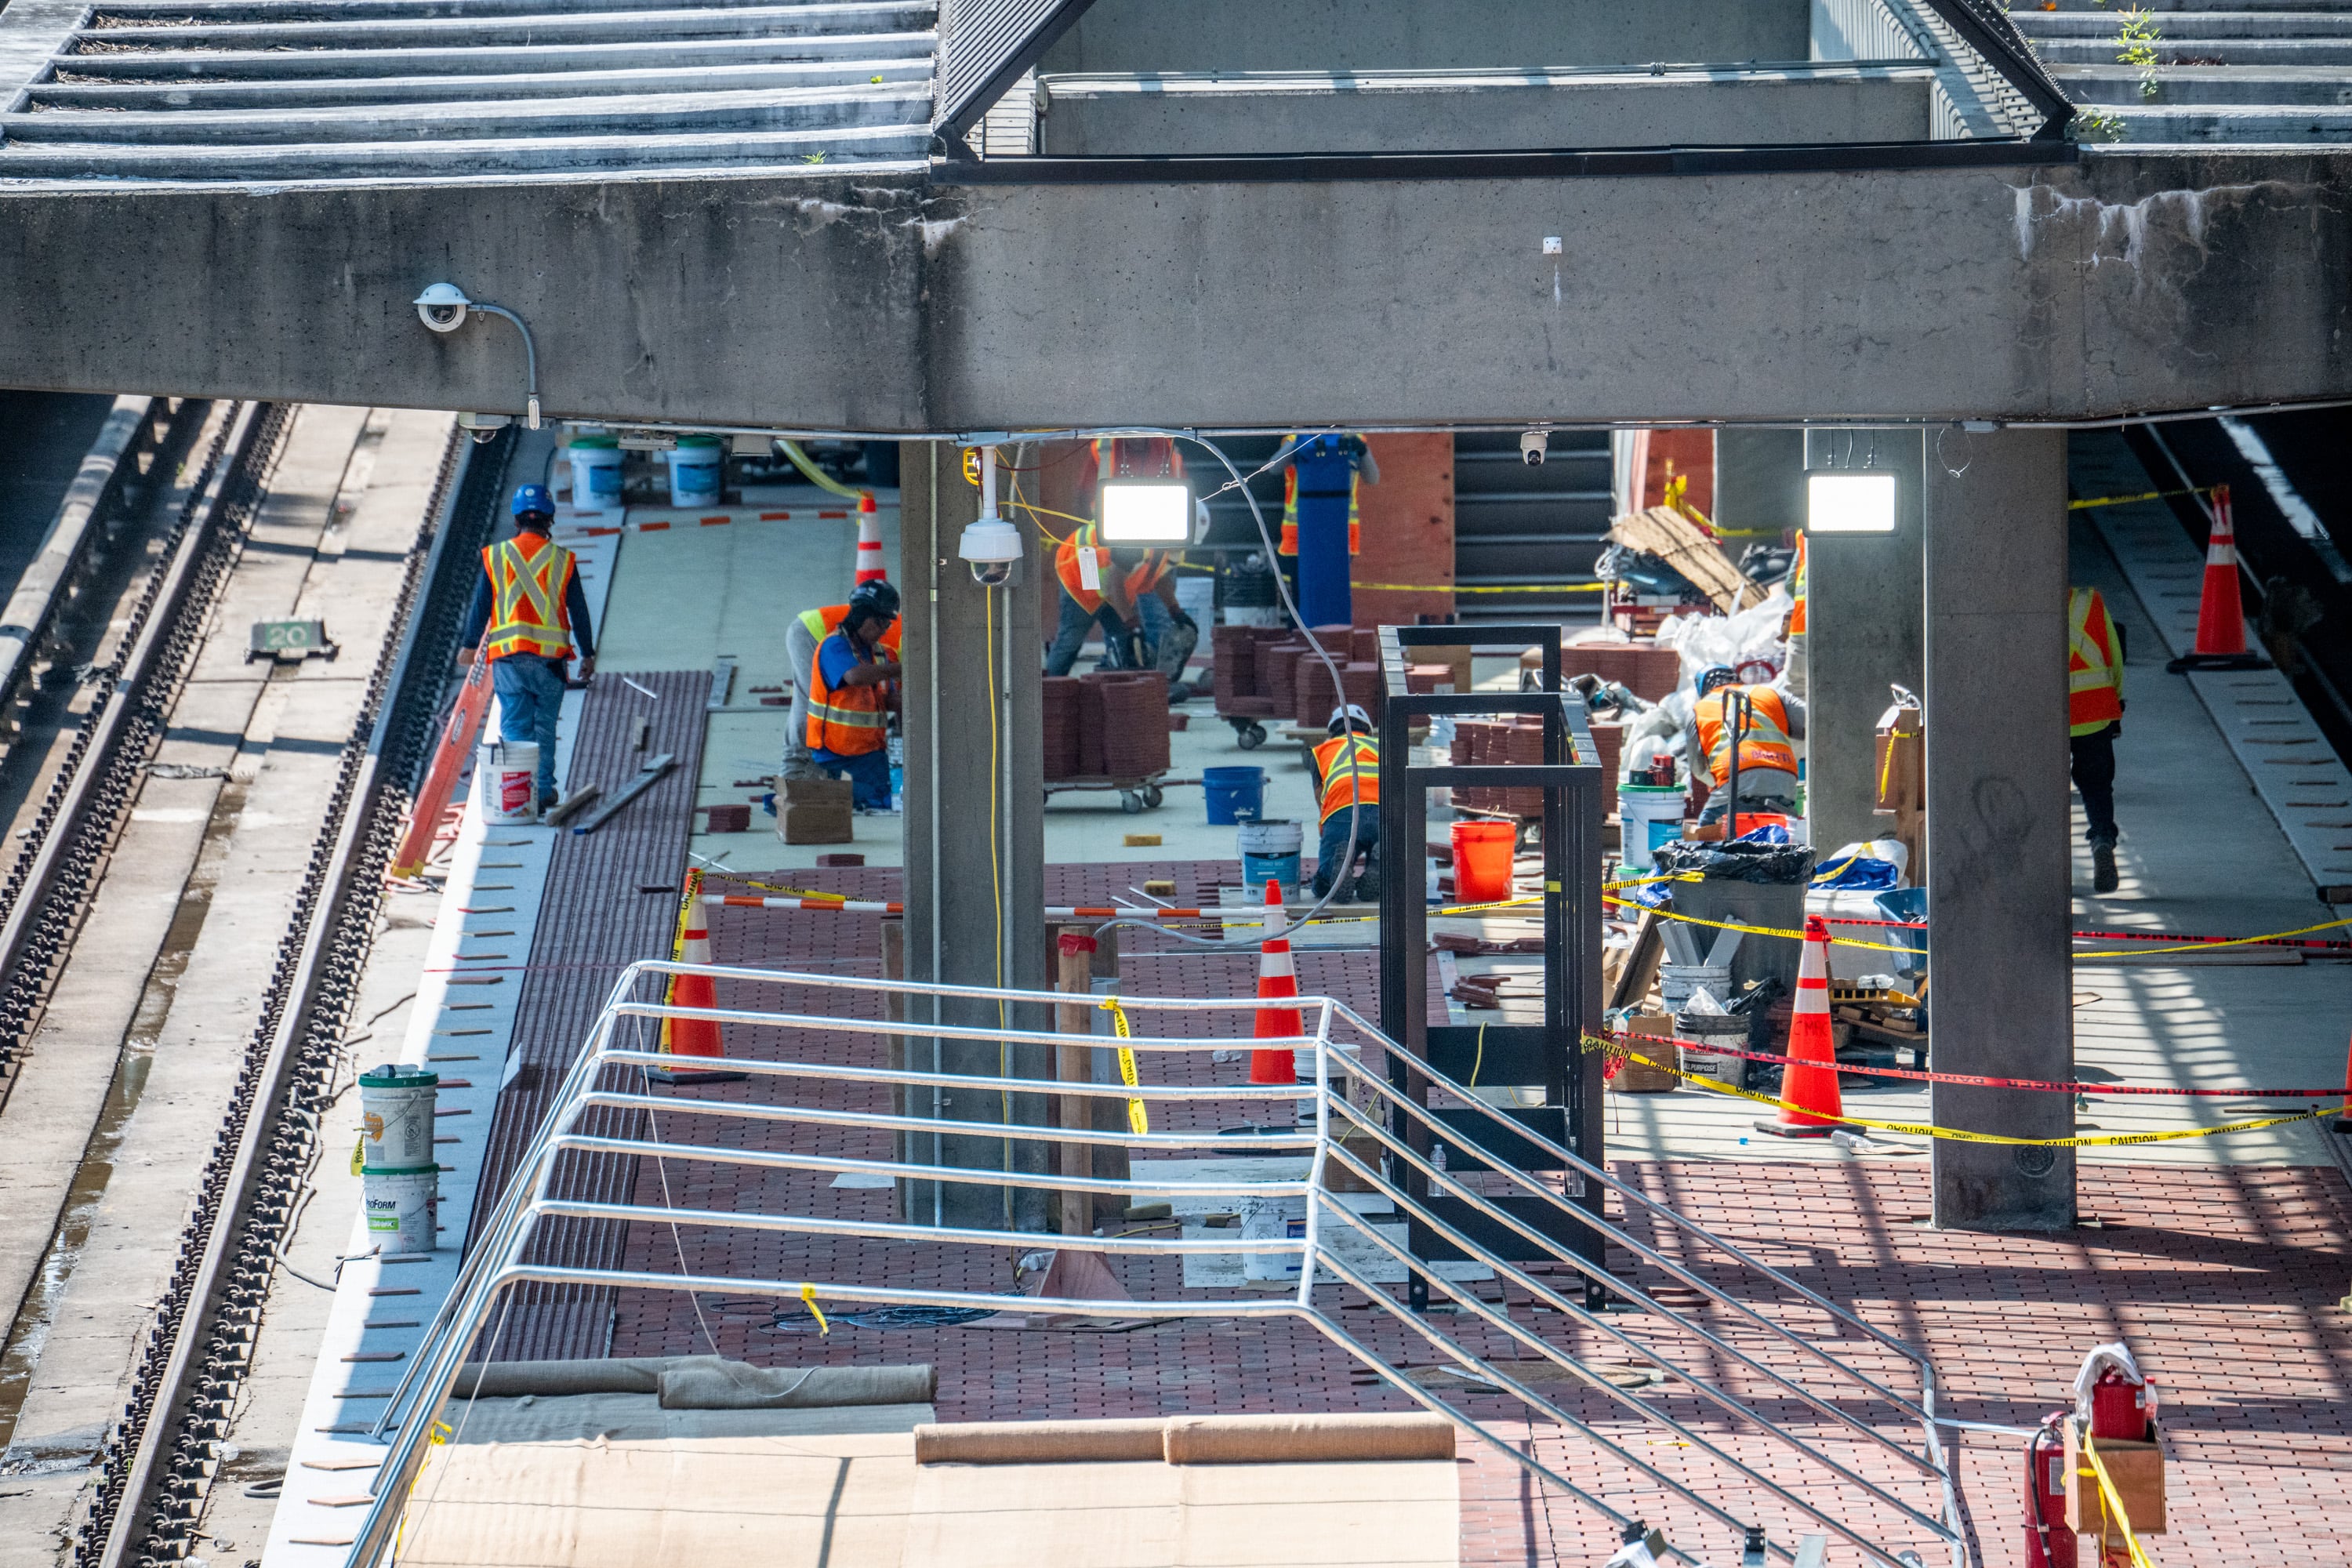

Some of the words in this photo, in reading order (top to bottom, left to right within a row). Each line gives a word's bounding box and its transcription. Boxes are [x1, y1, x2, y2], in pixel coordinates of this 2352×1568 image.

[268, 625, 307, 645] 20
[1603, 878, 1639, 891] AUTION
[1585, 1038, 1632, 1059] CAUTION
[1691, 1064, 1717, 1073] PURPOSE
[1901, 1070, 1985, 1084] DANGER
[2110, 1135, 2158, 1146] CAUTION
